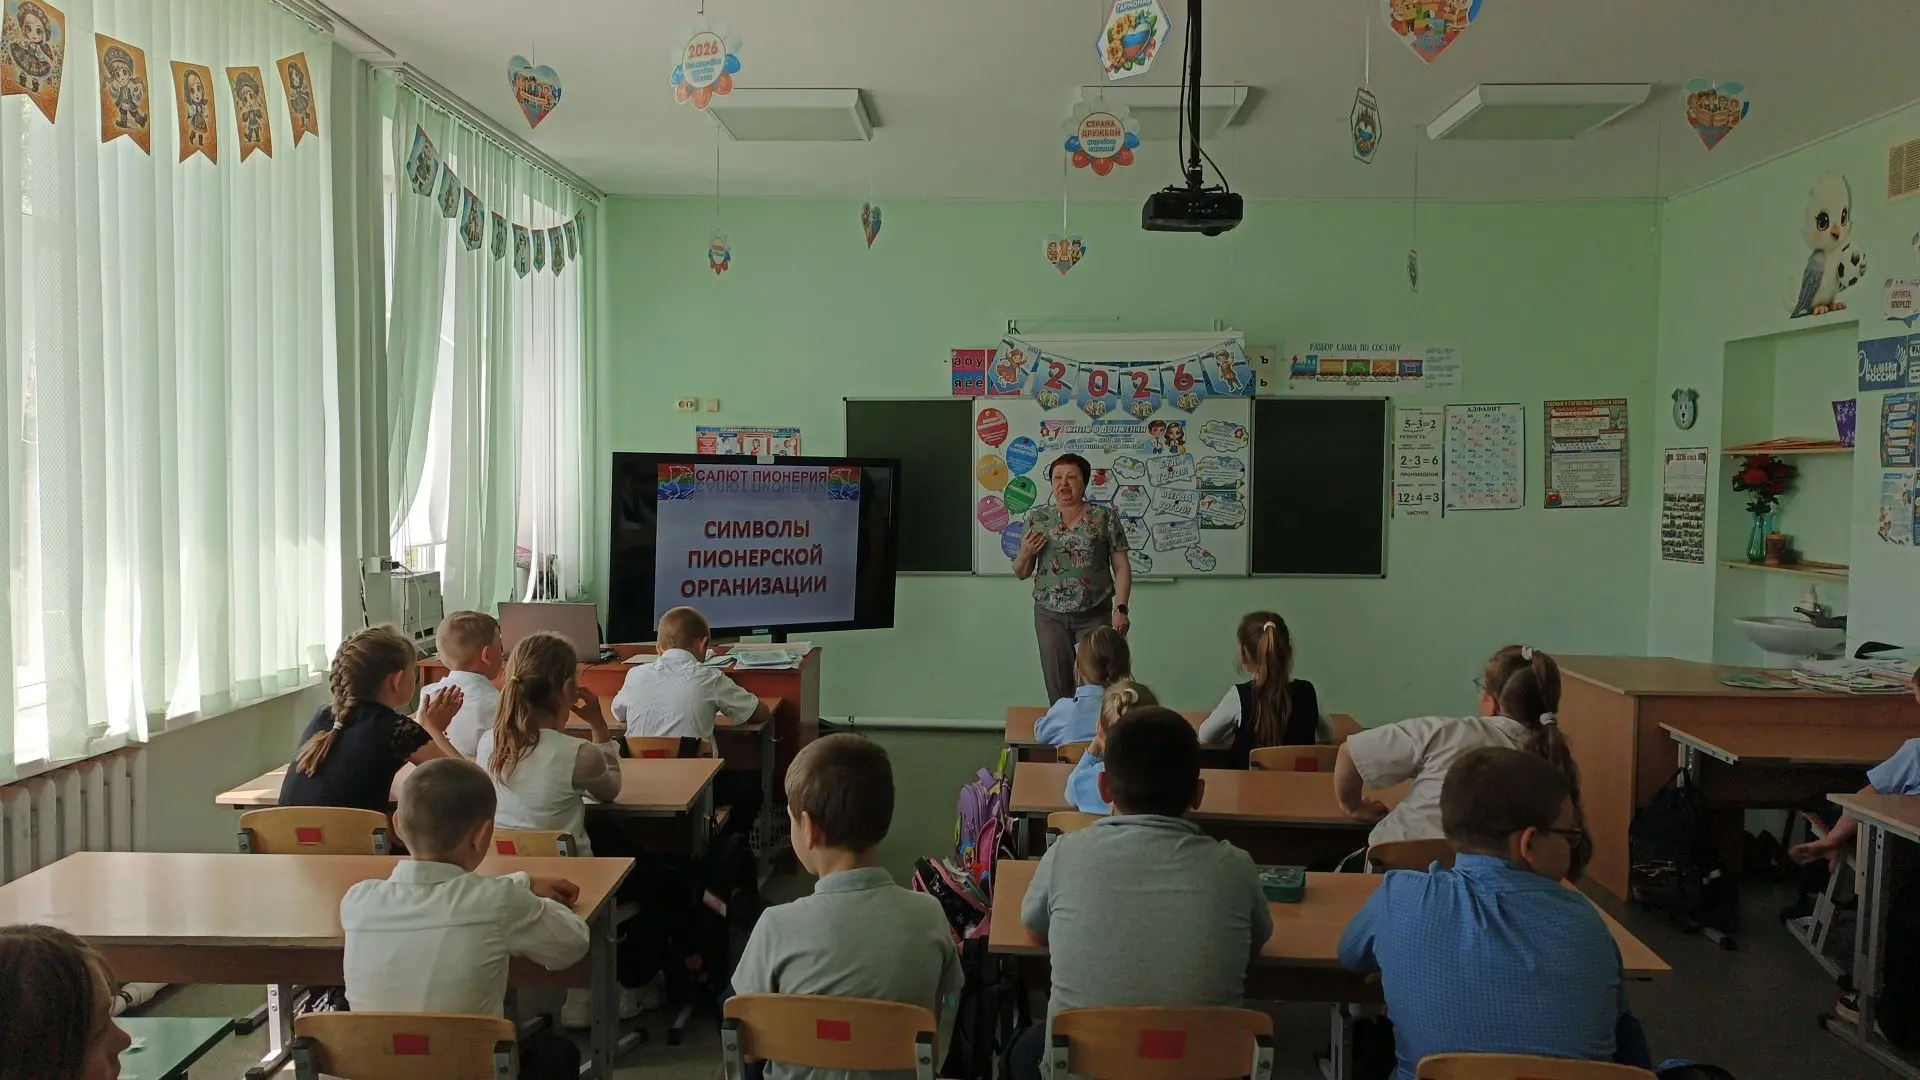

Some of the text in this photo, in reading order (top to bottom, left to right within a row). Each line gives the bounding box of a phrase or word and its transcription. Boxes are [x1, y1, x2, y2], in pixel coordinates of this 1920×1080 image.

[687, 41, 719, 59] 2026
[1359, 343, 1369, 351] ПО
[1866, 371, 1897, 382] РОССИИ
[695, 470, 827, 483] САЛЮТ ПИОНЕРИЯ
[704, 520, 810, 540] СИМВОЛЫ
[688, 543, 823, 569] ПИОНЕРСКОЙ
[680, 575, 827, 598] ОРГАНИЗАЦИИ
